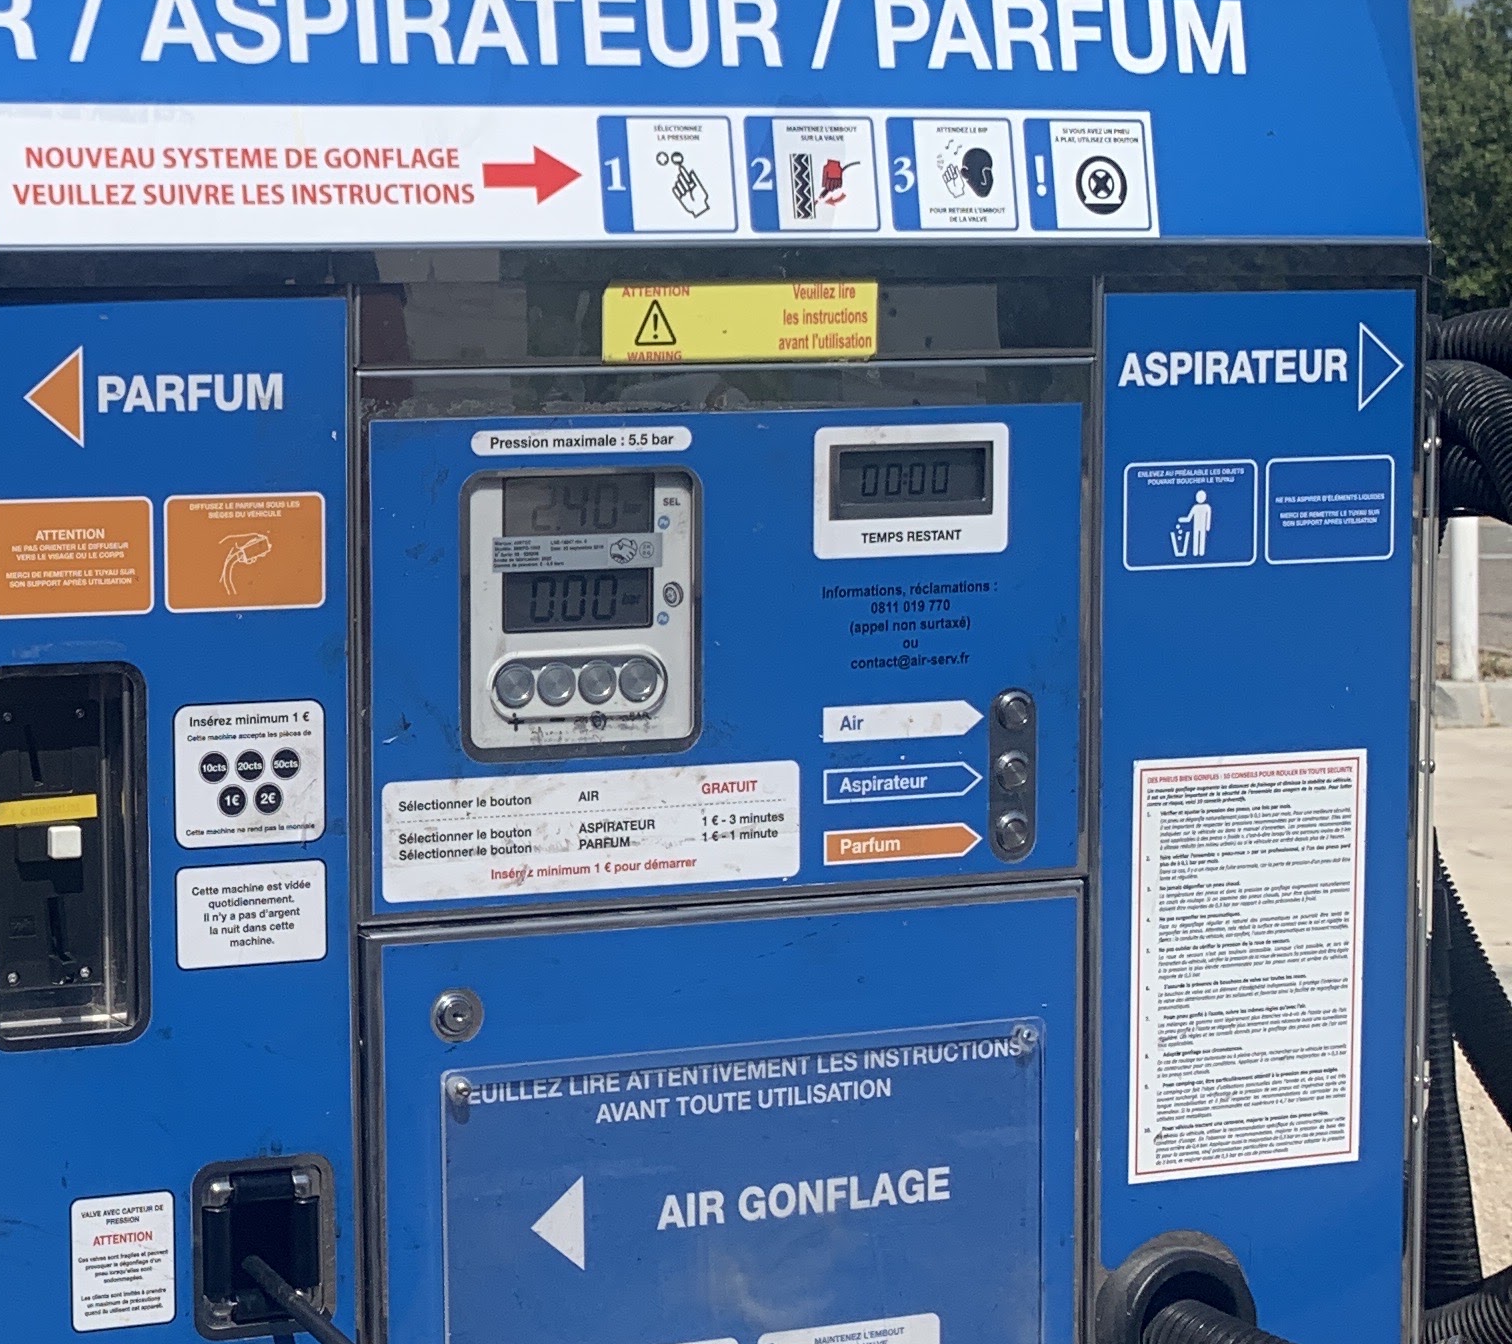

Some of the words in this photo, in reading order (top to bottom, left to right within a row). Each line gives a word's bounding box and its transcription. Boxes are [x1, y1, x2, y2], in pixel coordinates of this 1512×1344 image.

[25, 147, 155, 168] NOUVEAU
[162, 147, 278, 169] SYSTEME
[284, 147, 318, 169] DE
[324, 148, 459, 169] GONFLAGE
[604, 157, 627, 192] 1
[750, 157, 774, 192] 2
[893, 157, 916, 194] 3
[13, 184, 136, 205] VEUILLEZ
[143, 184, 235, 205] SUIVRE
[241, 183, 285, 205] LES
[291, 183, 475, 205] INSTRUCTIONS
[622, 286, 690, 298] ATTENTION
[793, 284, 836, 300] Veuillez
[838, 284, 856, 299] lire
[782, 308, 799, 325] les
[802, 308, 868, 325] instructions
[778, 334, 809, 350] avant
[812, 333, 873, 349] l'utilisation
[627, 351, 682, 361] WARNING
[1119, 349, 1348, 386] ASPIRATEUR
[97, 373, 283, 412] PARFUM
[489, 436, 549, 449] Pression
[552, 434, 617, 447] maximale
[628, 433, 648, 446] 5.5
[651, 433, 674, 445] bar
[662, 497, 681, 507] SEL
[35, 528, 105, 540] ATTENTION
[861, 531, 904, 544] TEMPS
[906, 529, 961, 542] RESTANT
[820, 584, 906, 598] Informations,
[909, 581, 990, 595] réclamations
[871, 602, 898, 615] 0811
[903, 601, 925, 613] 019
[928, 599, 951, 612] 770
[848, 619, 889, 636] (appel
[892, 620, 917, 631] non
[919, 616, 971, 630] surtaxé)
[902, 638, 919, 649] ou
[850, 652, 970, 670] contact@air-serv.fr
[189, 715, 232, 727] Insérez
[235, 713, 289, 725] minimum
[293, 712, 298, 722] 1
[302, 711, 310, 722] €
[839, 715, 864, 731] Air
[202, 763, 227, 774] 10cts
[237, 761, 263, 772] 20cts
[273, 759, 299, 770] 50cts
[839, 775, 928, 794] Aspirateur
[224, 794, 240, 807] 1€
[260, 792, 276, 805] 2€
[398, 799, 473, 812] Sélectionner
[476, 796, 487, 807] le
[489, 795, 532, 807] bouton
[578, 790, 599, 802] AIR
[701, 780, 758, 794] GRATUIT
[398, 832, 473, 845] Sélectionner
[476, 829, 487, 840] le
[490, 827, 532, 842] bouton
[578, 819, 655, 833] ASPIRATEUR
[702, 815, 707, 826] 1
[711, 814, 719, 826] €
[729, 813, 737, 825] 3
[739, 812, 785, 824] minutes
[399, 848, 474, 861] Sélectionner
[477, 845, 487, 856] le
[490, 844, 532, 856] bouton
[578, 836, 631, 850] PARFUM
[702, 832, 708, 842] 1
[712, 831, 719, 842] €
[730, 830, 735, 841] 1
[739, 828, 779, 840] minute
[840, 838, 901, 855] Parfum
[536, 865, 591, 877] minimum
[594, 862, 600, 873] 1
[604, 861, 611, 873] €
[613, 862, 641, 874] pour
[643, 858, 697, 870] démarrer
[191, 886, 219, 896] Cette
[221, 883, 264, 894] machine
[266, 881, 282, 891] est
[284, 879, 311, 890] vidée
[203, 912, 210, 922] Il
[211, 911, 227, 923] n'y
[229, 912, 236, 921] a
[238, 911, 257, 921] pas
[258, 907, 300, 919] d'argent
[209, 926, 219, 935] la
[220, 924, 240, 934] nuit
[242, 923, 267, 933] dans
[269, 921, 295, 931] cette
[229, 936, 274, 947] machine.
[469, 1079, 563, 1104] EUILLEZ
[568, 1073, 620, 1096] LIRE
[625, 1058, 807, 1090] ATTENTIVEMENT
[816, 1052, 858, 1074] LES
[596, 1098, 670, 1123] AVANT
[676, 1090, 751, 1115] TOUTE
[756, 1078, 892, 1108] UTILISATION
[657, 1190, 725, 1230] AIR
[738, 1167, 950, 1220] GONFLAGE
[80, 1210, 102, 1218] VALVE
[102, 1208, 121, 1216] AVEC
[121, 1205, 153, 1214] CAPTEUR
[105, 1216, 140, 1225] PRESSION
[92, 1231, 153, 1246] ATTENTION
[813, 1332, 862, 1344] MAINTENEZ
[863, 1326, 904, 1339] L'EMBOUT
